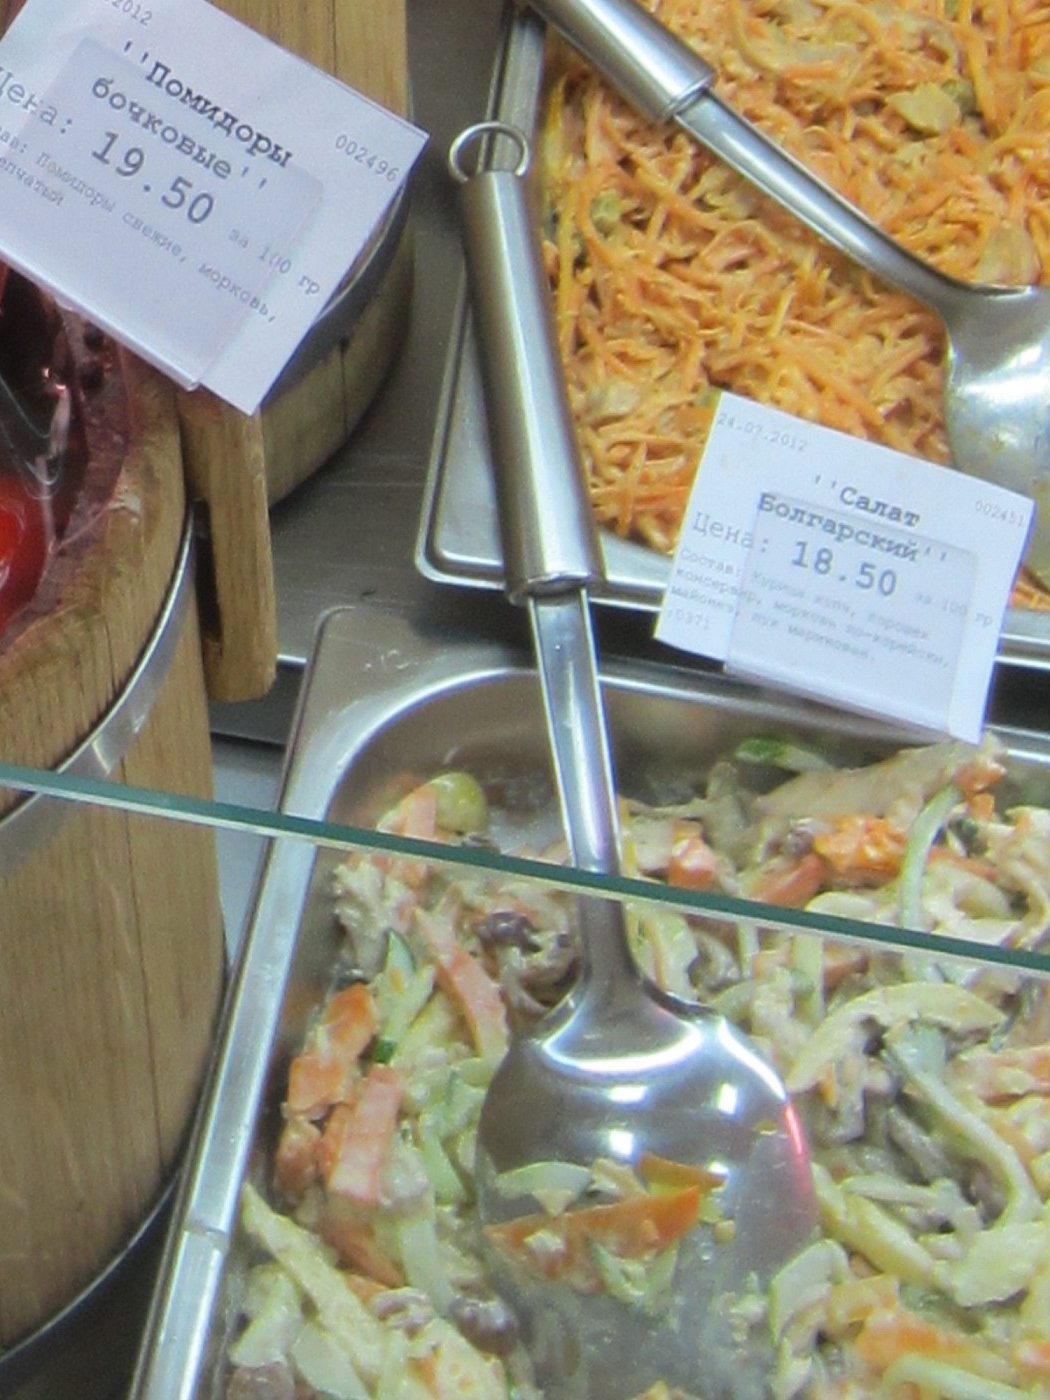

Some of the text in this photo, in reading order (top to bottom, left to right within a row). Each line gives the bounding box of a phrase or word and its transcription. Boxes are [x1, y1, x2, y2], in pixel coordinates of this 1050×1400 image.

[90, 130, 215, 224] 19.50
[297, 274, 320, 295] гр
[334, 133, 400, 182] 002496
[34, 150, 116, 213] Помидоры
[121, 211, 187, 263] свежие,
[197, 262, 276, 323] морковь,
[691, 510, 769, 553] Цена:
[791, 540, 897, 597] 18.50
